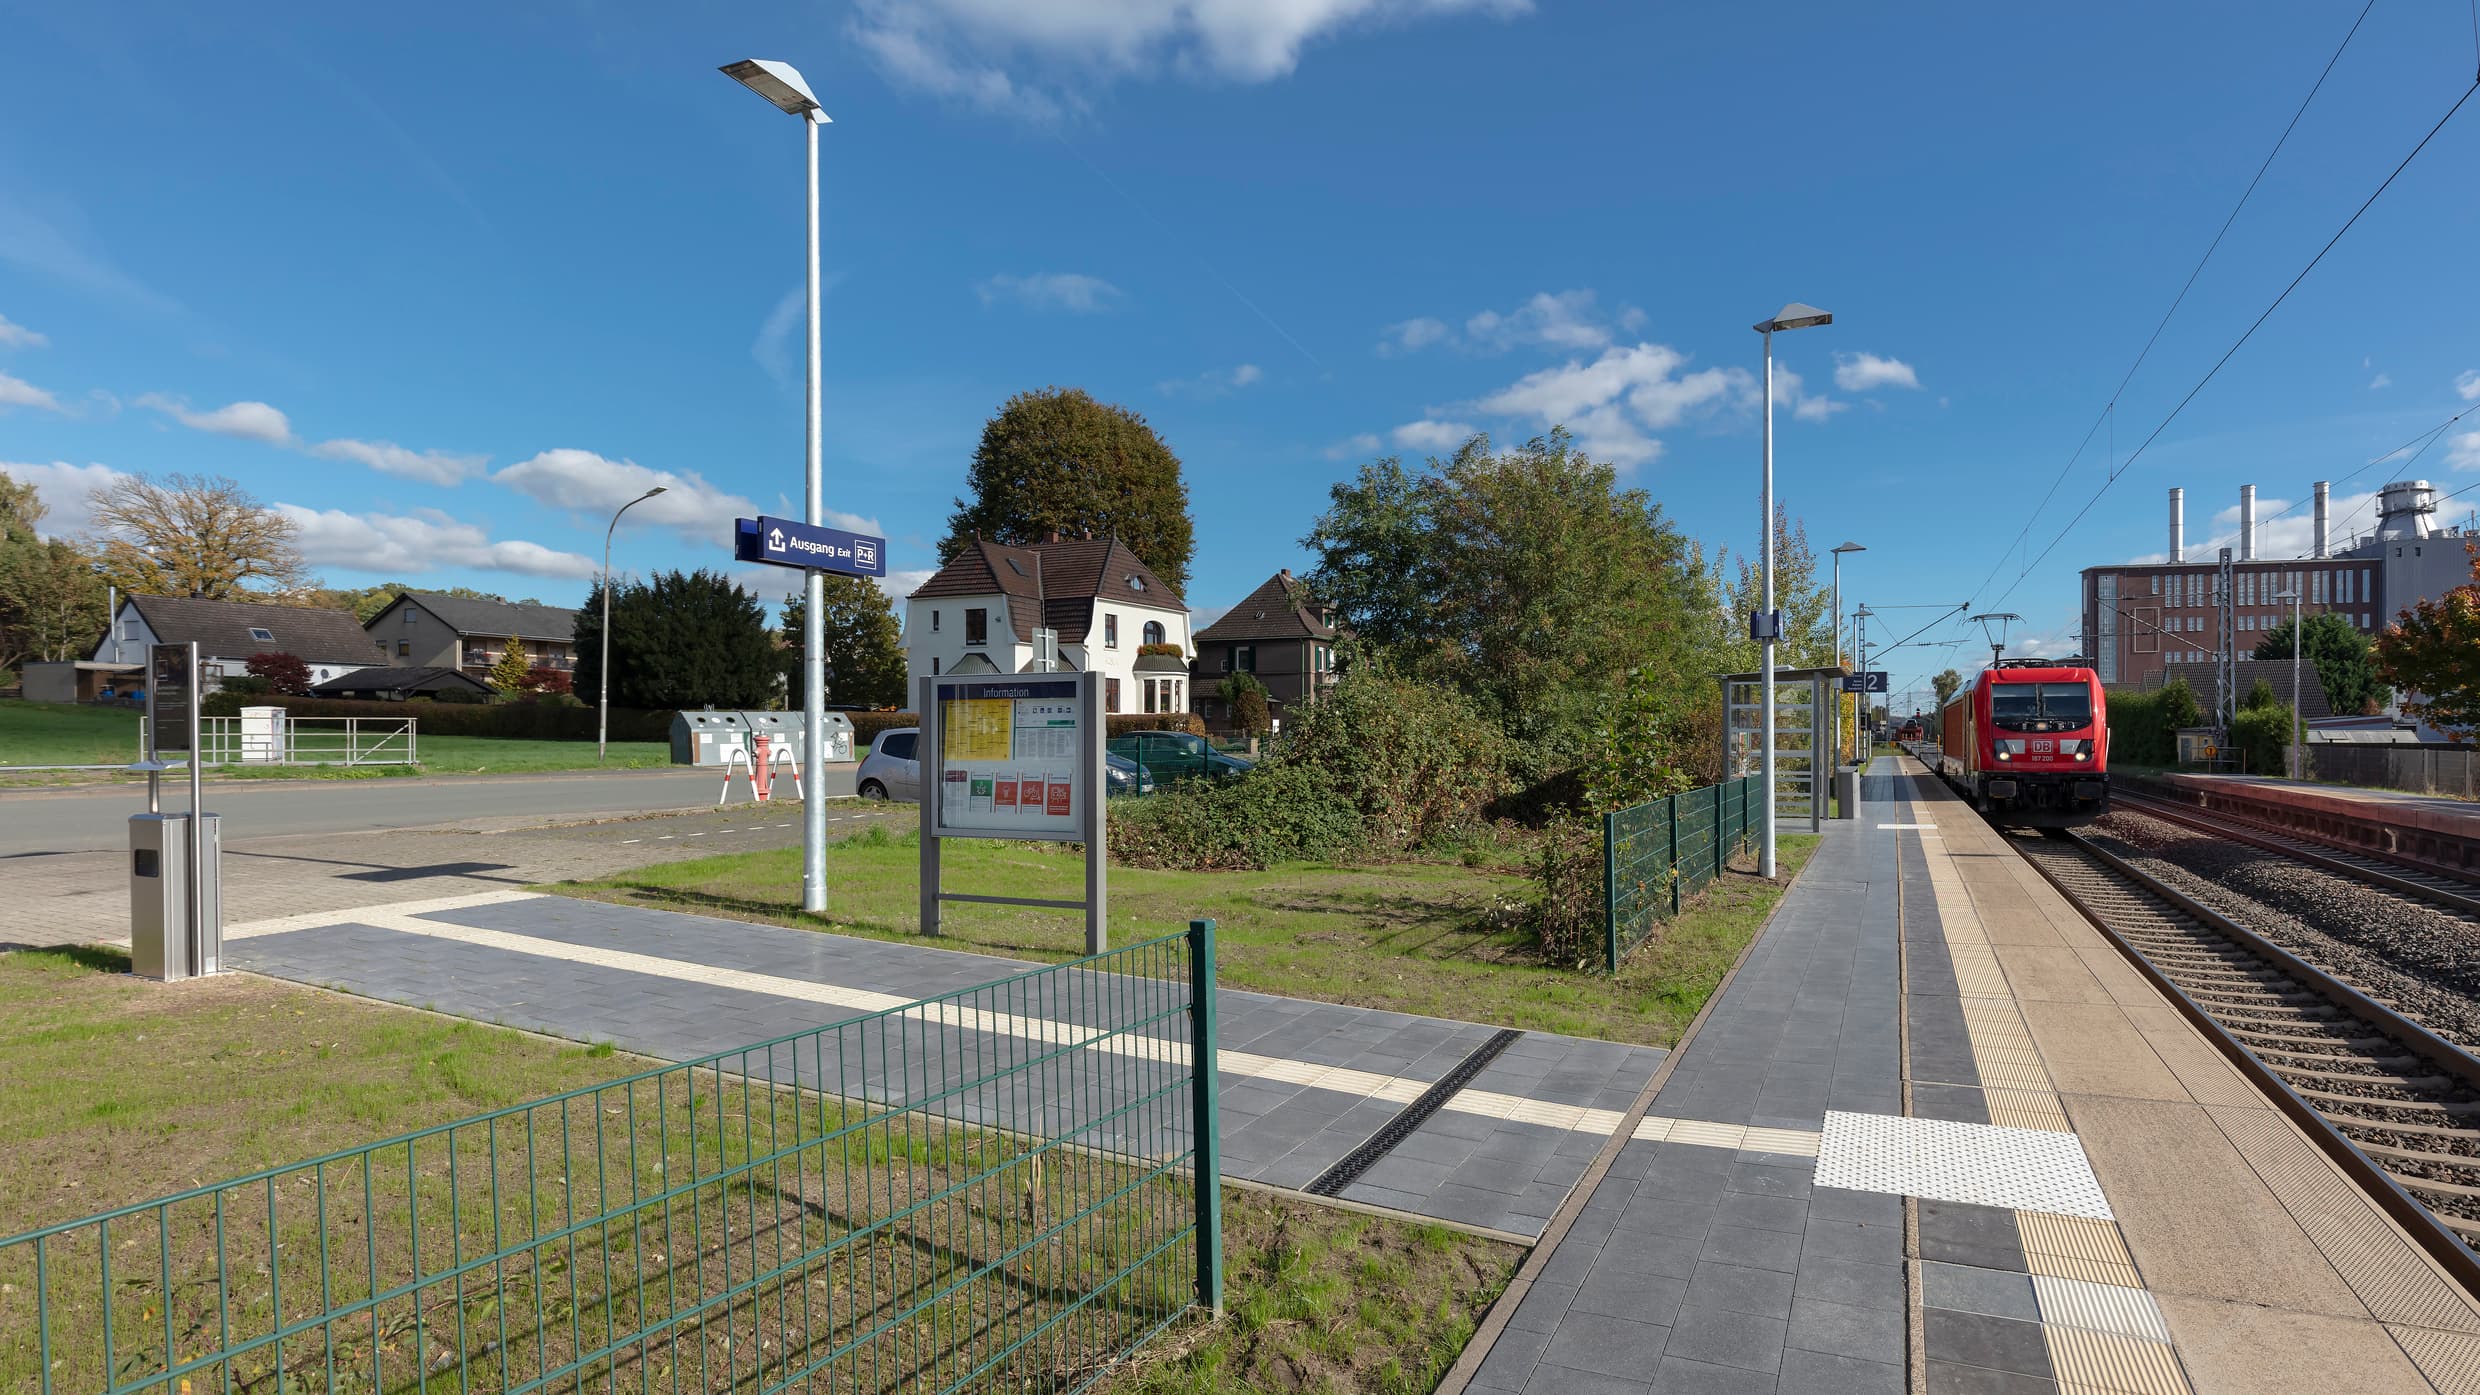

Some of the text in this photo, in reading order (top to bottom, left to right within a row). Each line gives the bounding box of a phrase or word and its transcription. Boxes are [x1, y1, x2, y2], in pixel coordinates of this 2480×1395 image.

[790, 536, 874, 562] Ausgang Exit P+R
[1867, 674, 1878, 690] 2
[983, 687, 1029, 698] Information
[2034, 741, 2050, 752] DB
